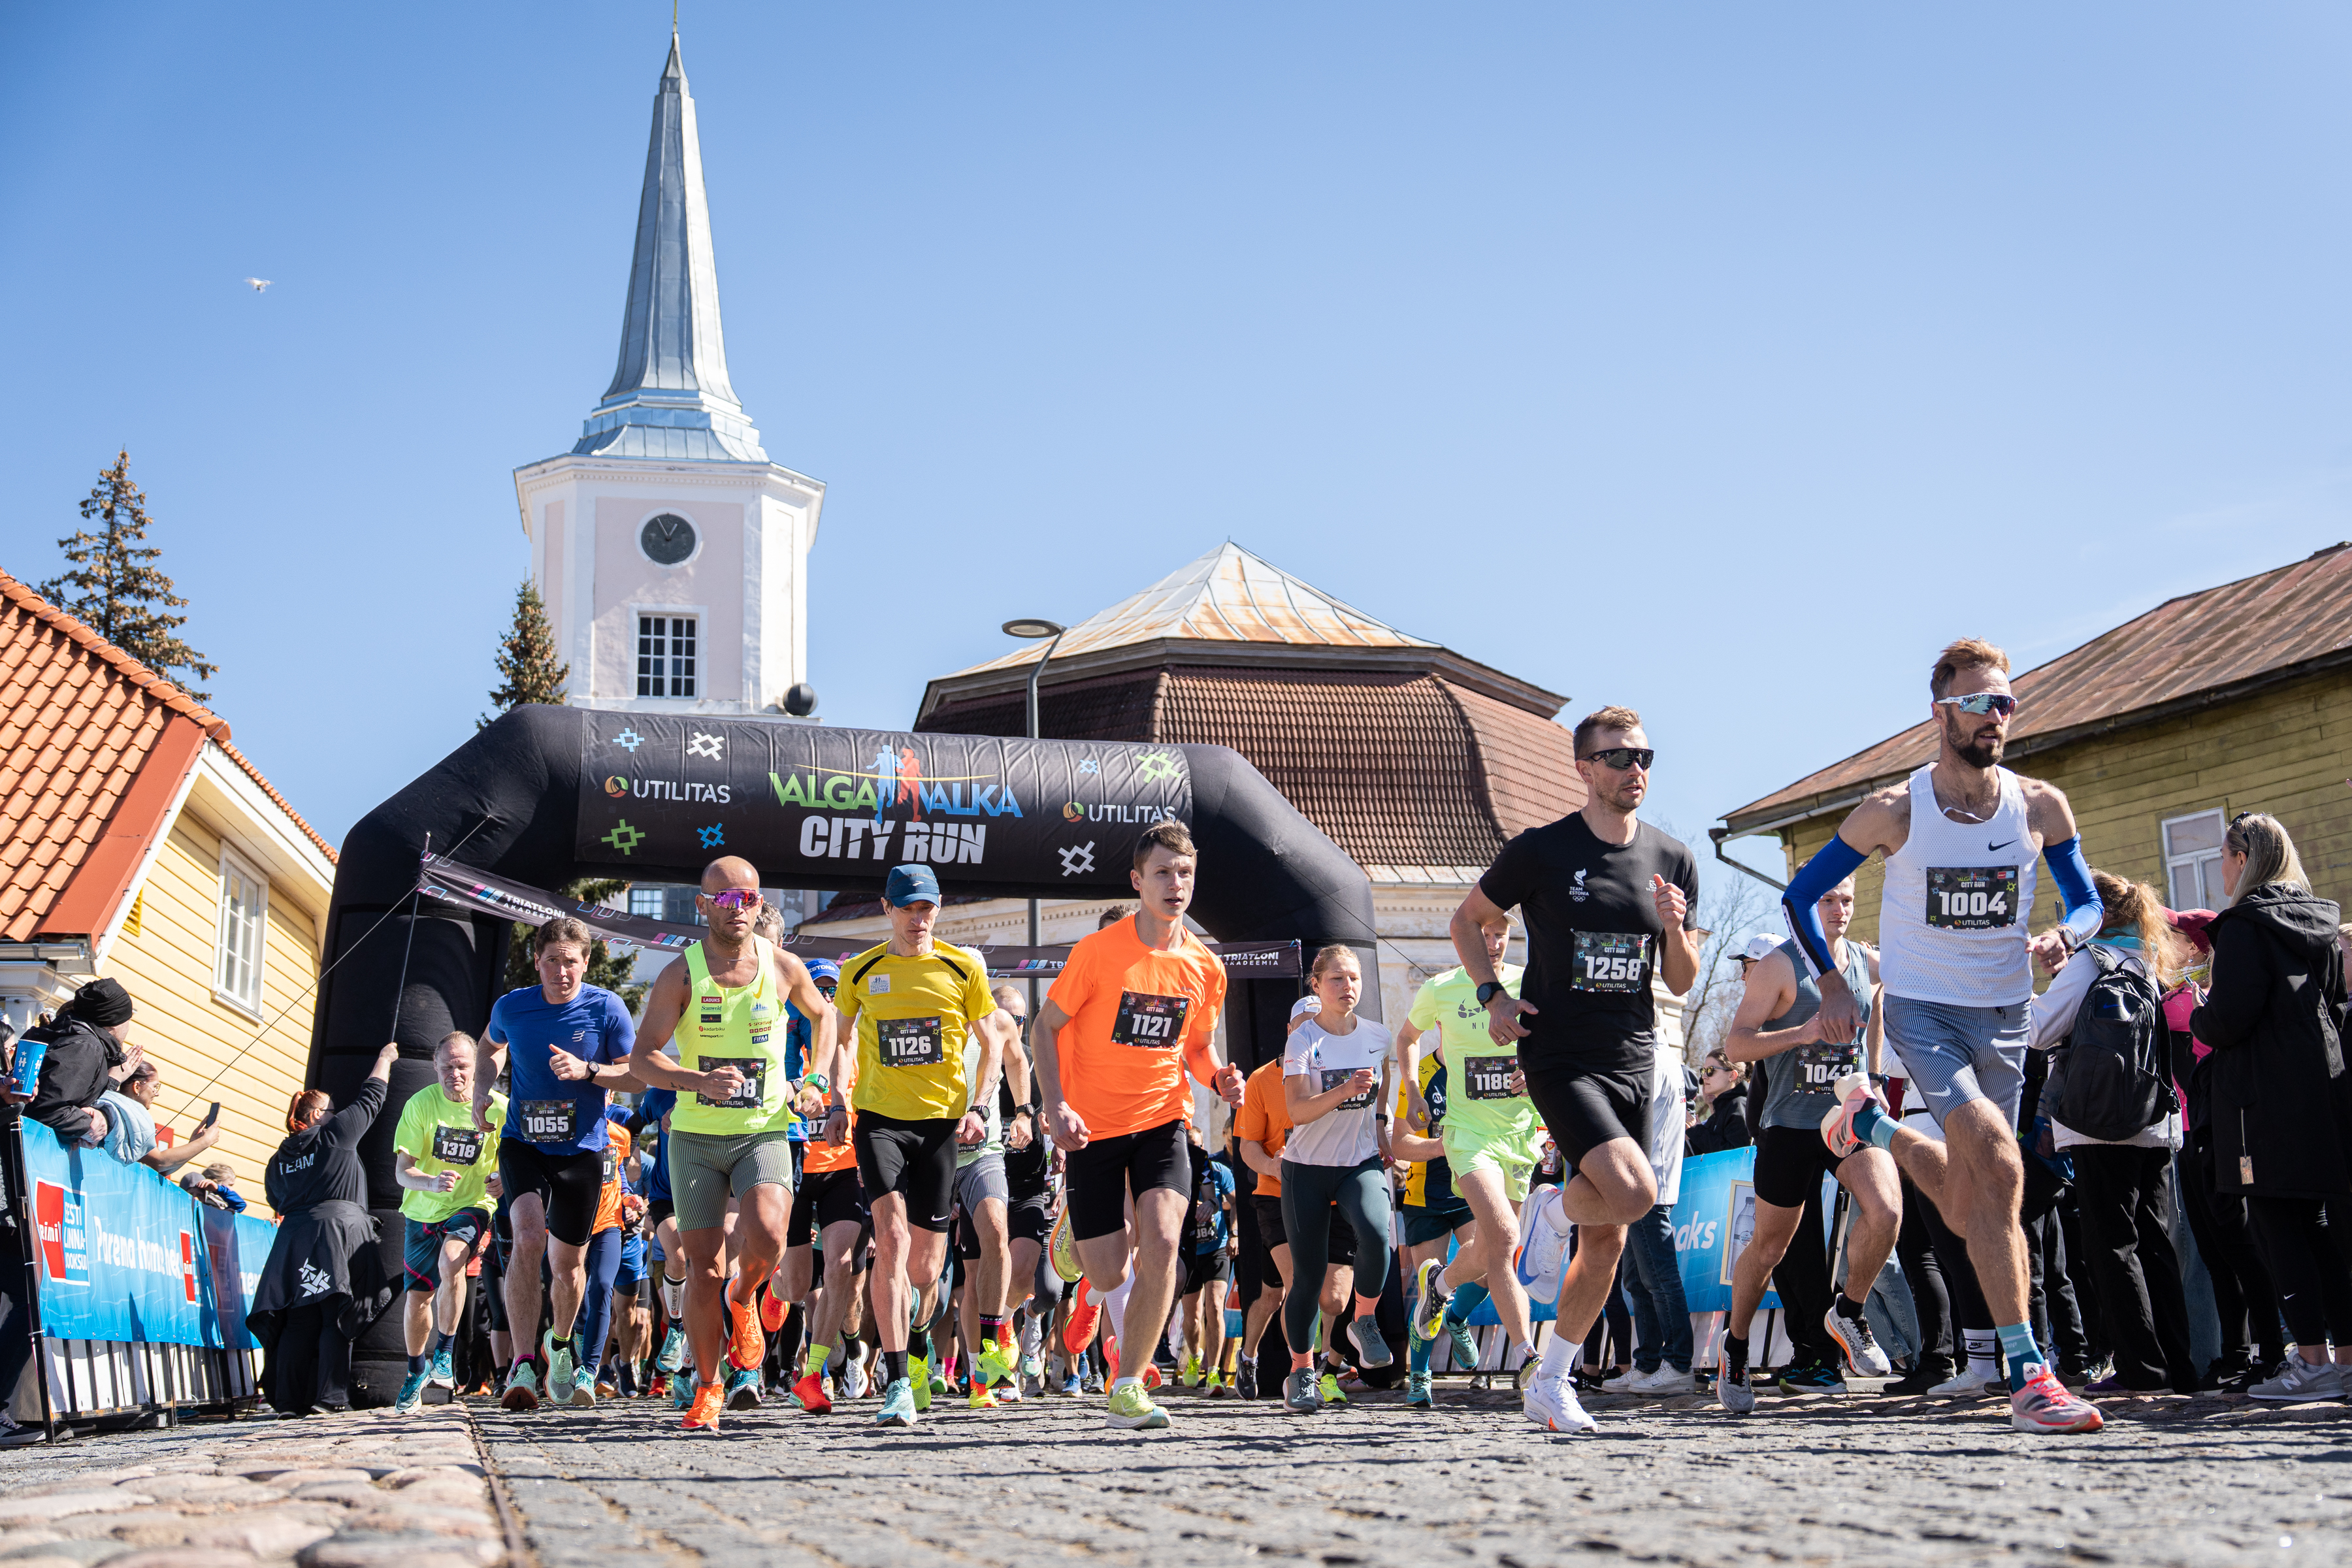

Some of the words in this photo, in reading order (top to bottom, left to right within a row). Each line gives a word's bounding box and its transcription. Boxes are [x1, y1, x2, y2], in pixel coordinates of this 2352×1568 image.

[633, 779, 730, 804] UTILITAS
[768, 772, 877, 811] VALGA
[919, 781, 1023, 818] VALKA
[1089, 804, 1176, 823] UTILITAS
[800, 815, 895, 860] CITY
[902, 821, 986, 864] RUN
[503, 902, 557, 920] AKADEEM
[505, 894, 566, 919] TRIATLONI
[1939, 891, 2007, 915] 1004
[1224, 952, 1279, 961] TRIATLONI
[1585, 955, 1641, 980] 1258
[1132, 1013, 1172, 1037] 1121
[889, 1036, 932, 1056] 1126
[1475, 1073, 1514, 1090] 1188
[527, 1116, 568, 1133] 1055
[442, 1141, 476, 1158] 1318
[279, 1153, 314, 1175] TEAM
[93, 1216, 136, 1269] Parema
[1673, 1211, 1717, 1252] aks
[1838, 1321, 1863, 1359] BROOKS
